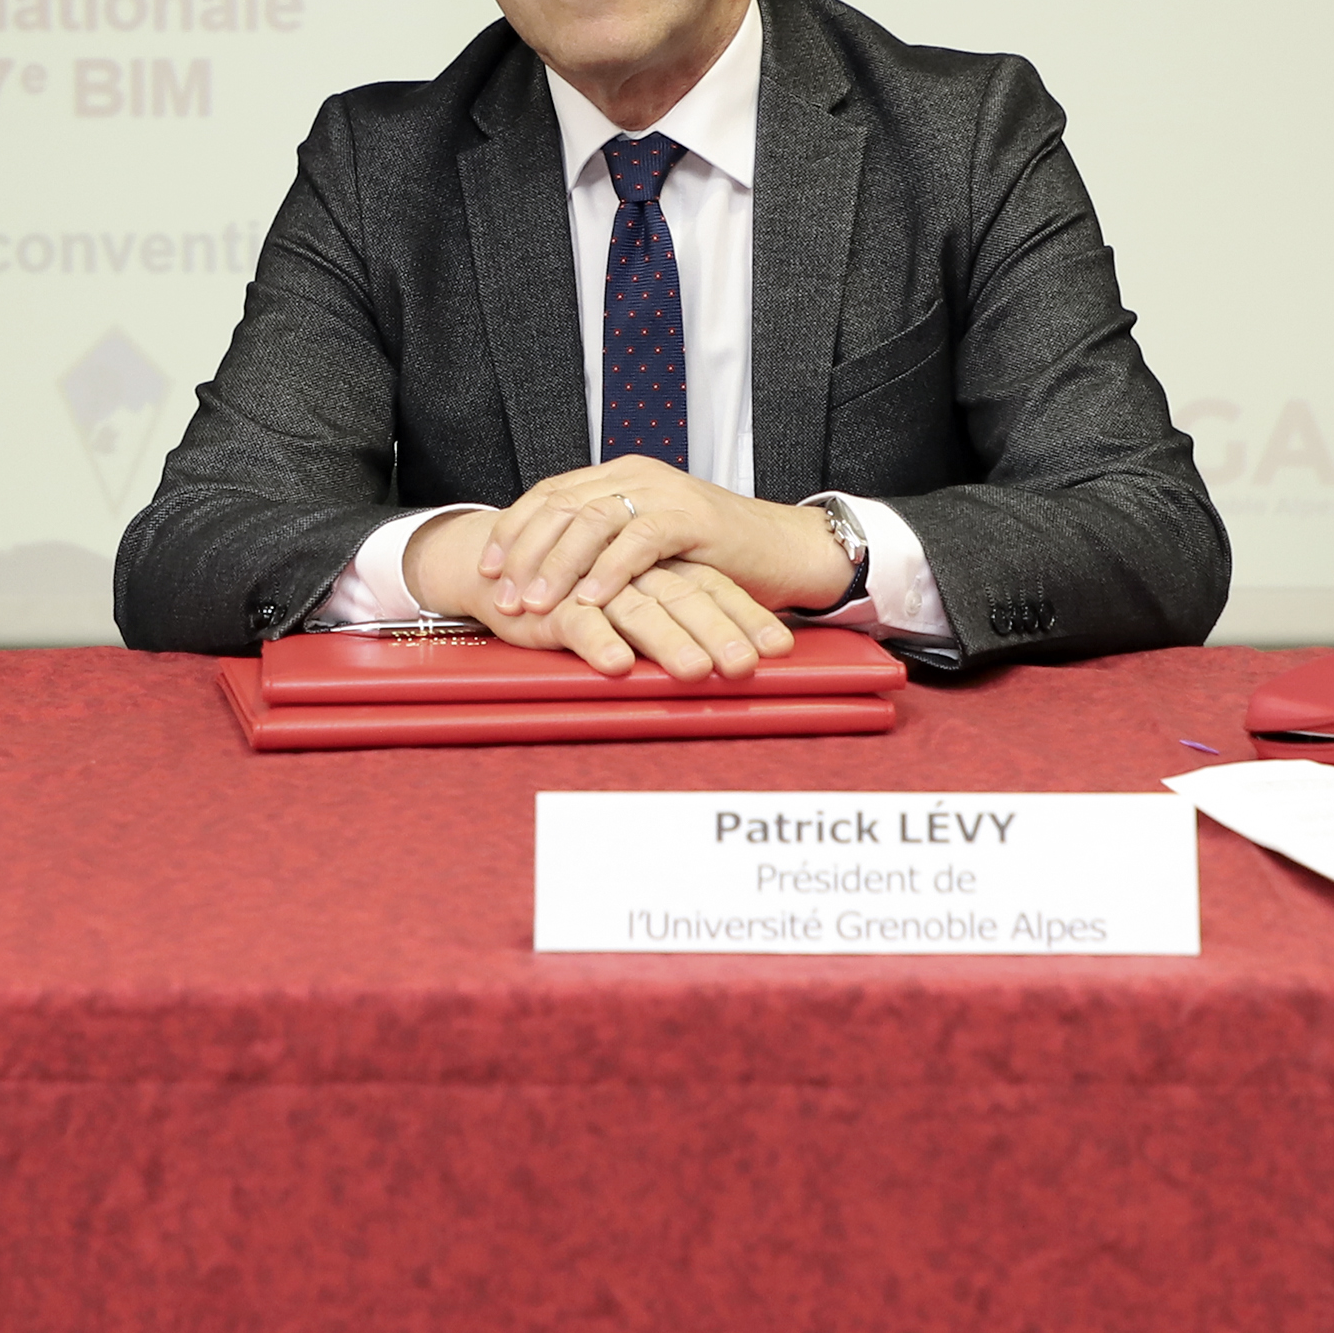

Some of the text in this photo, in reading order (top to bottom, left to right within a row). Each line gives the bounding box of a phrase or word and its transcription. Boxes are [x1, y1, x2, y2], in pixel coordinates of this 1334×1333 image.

[74, 58, 211, 118] BIM
[714, 801, 1017, 845] Patrick LÉVY
[755, 862, 977, 895] Président de
[834, 909, 999, 941] Grenoble
[1009, 910, 1108, 948] Alpes
